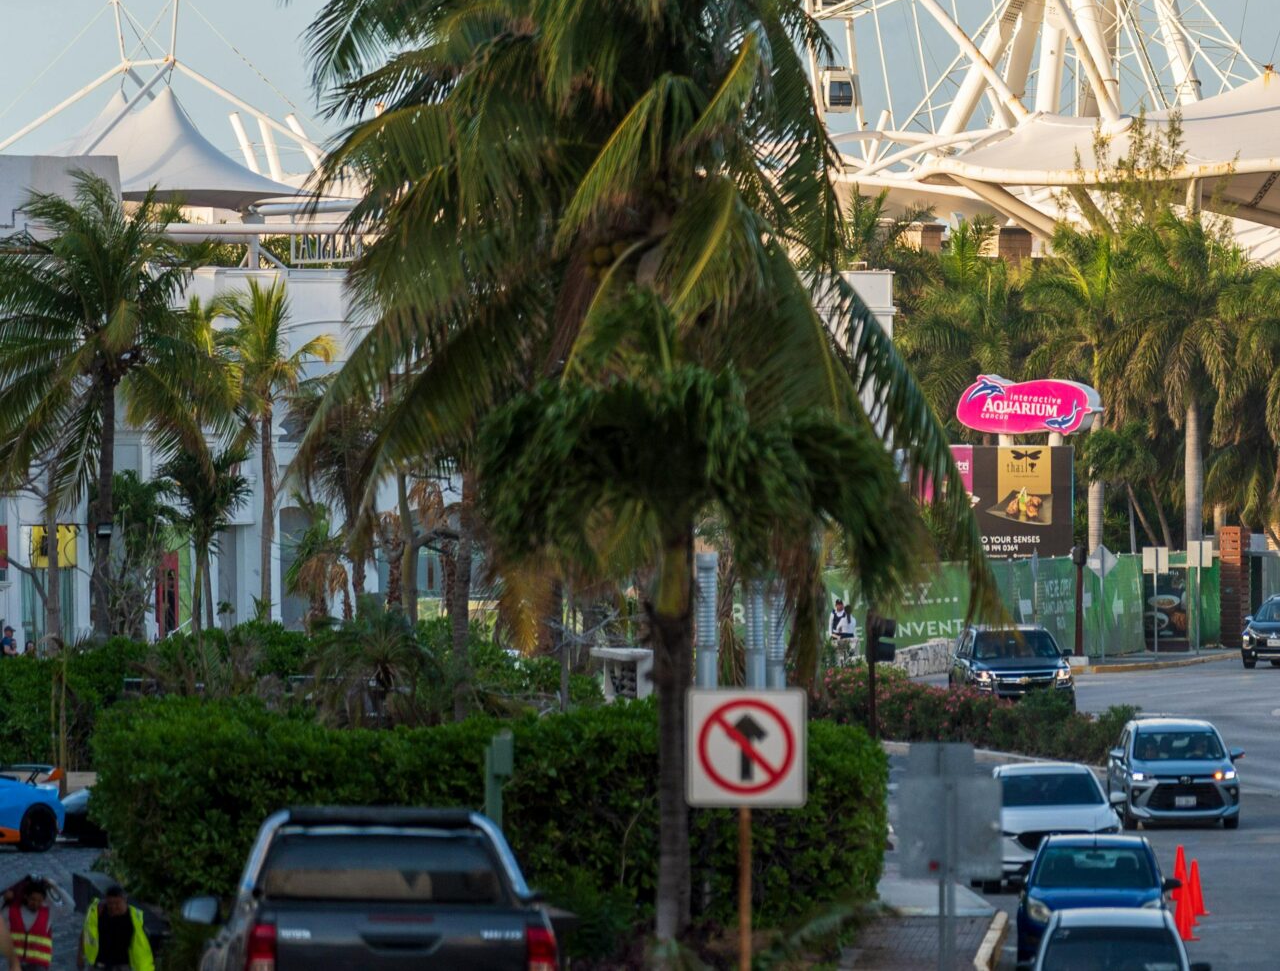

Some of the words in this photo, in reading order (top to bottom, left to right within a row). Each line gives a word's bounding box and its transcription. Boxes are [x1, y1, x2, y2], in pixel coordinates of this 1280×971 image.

[1010, 392, 1062, 405] interactive
[982, 397, 1058, 417] AQUARIUM
[990, 535, 1011, 544] YOUR
[1013, 535, 1041, 544] SENSES
